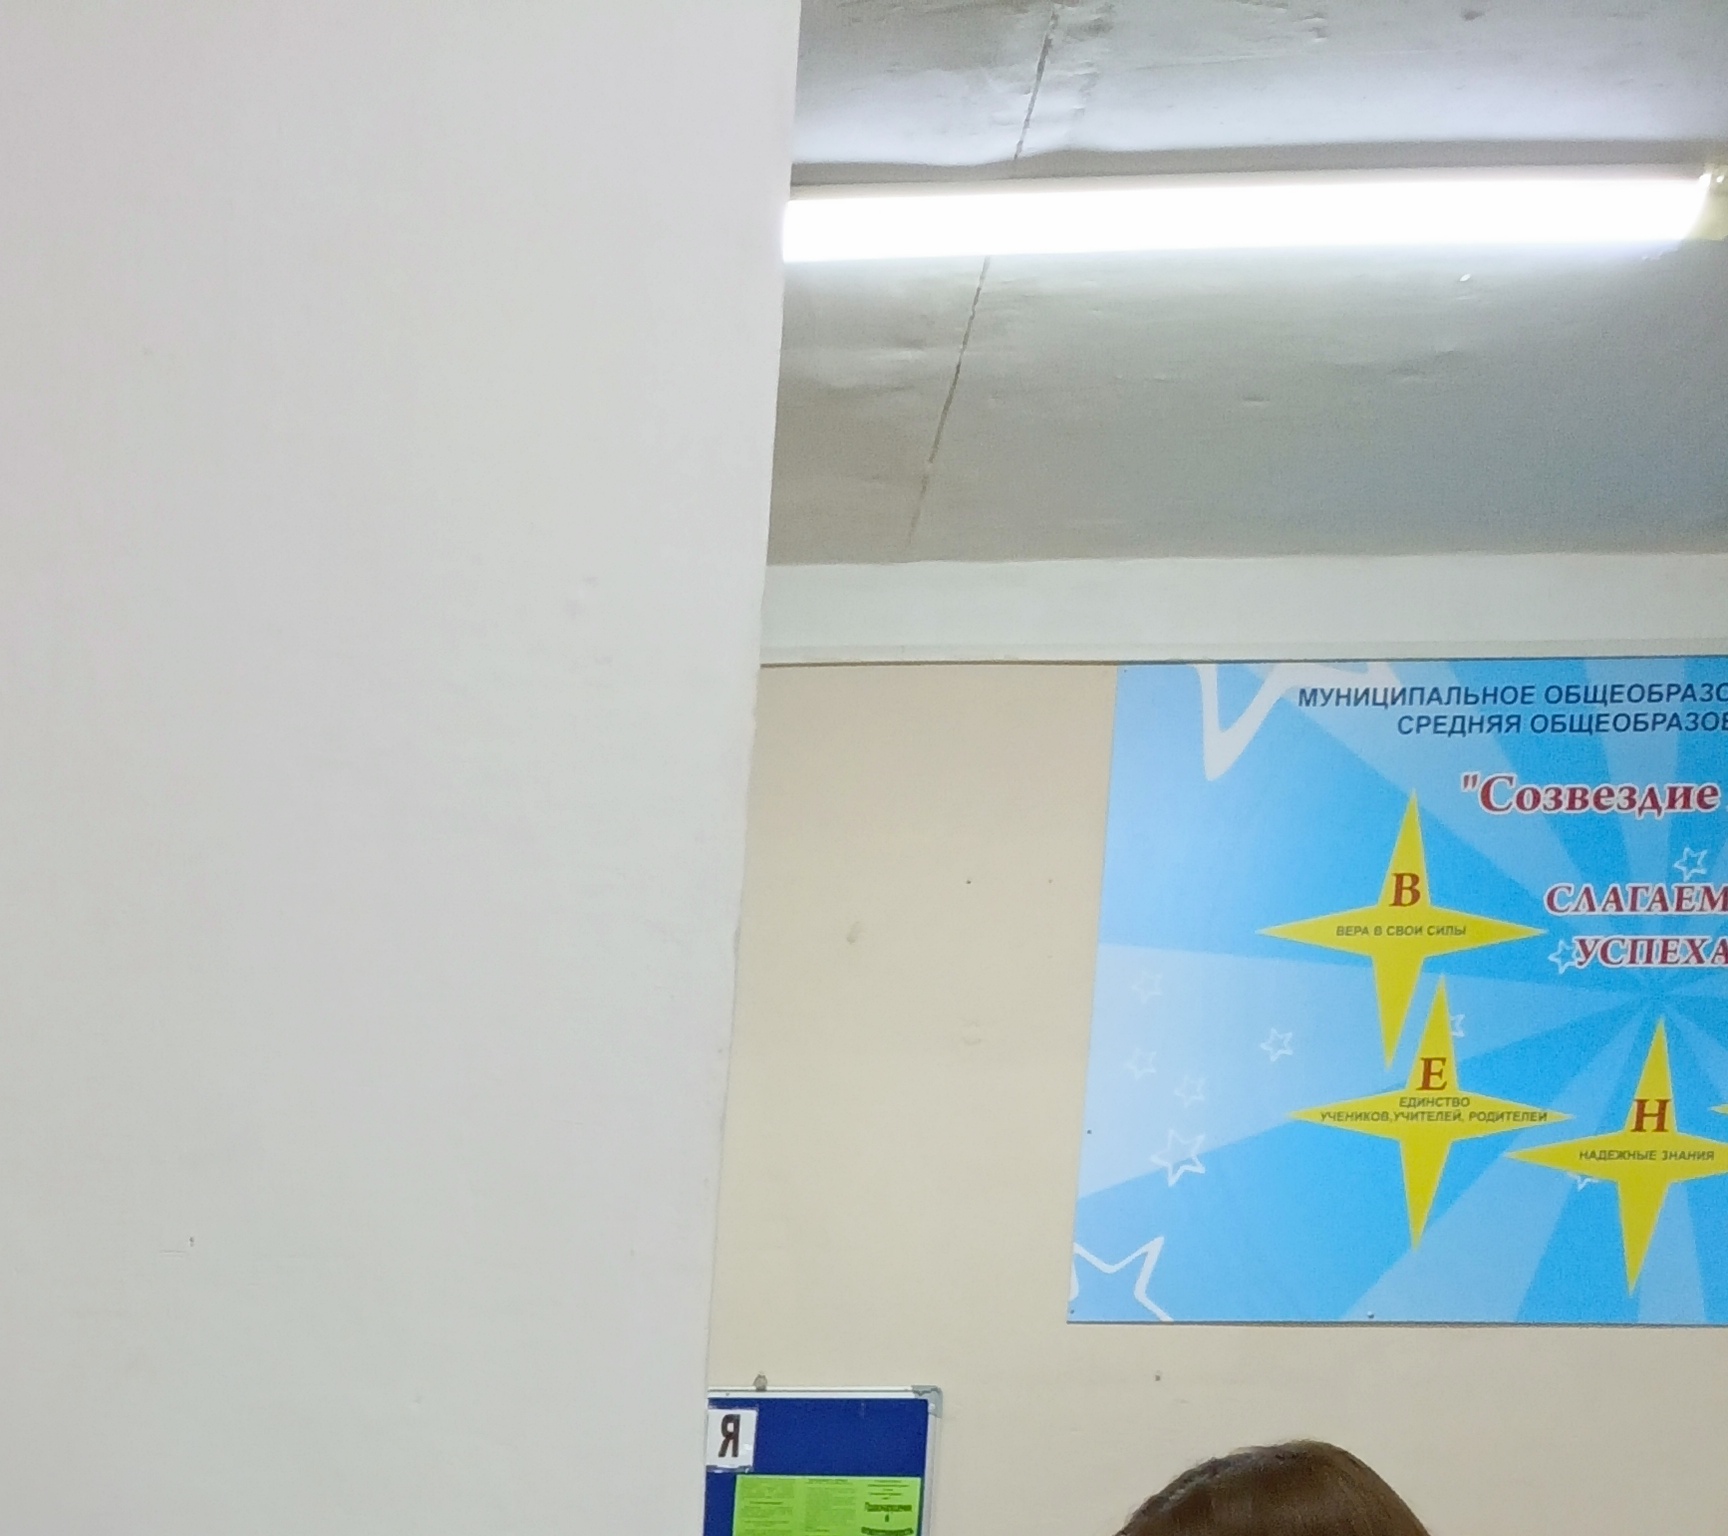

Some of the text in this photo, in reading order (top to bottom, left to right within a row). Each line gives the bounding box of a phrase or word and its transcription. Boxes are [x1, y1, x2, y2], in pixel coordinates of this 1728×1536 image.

[1298, 686, 1535, 710] МУНИЦИПАЛЬНОЕ
[1397, 714, 1521, 738] СРЕДНЯЯ
[1462, 773, 1719, 816] "Созвездие
[1389, 872, 1420, 907] В
[1336, 925, 1370, 937] ВЕРА
[1386, 925, 1423, 937] СВОИ
[1427, 924, 1467, 937] СИЛЫ
[1416, 1057, 1448, 1091] Е
[1399, 1097, 1471, 1110] ЕДИНСТВО
[1630, 1099, 1670, 1133] Н
[1579, 1149, 1715, 1162] НАДЕЖНЫЕ ЗНАНИЯ
